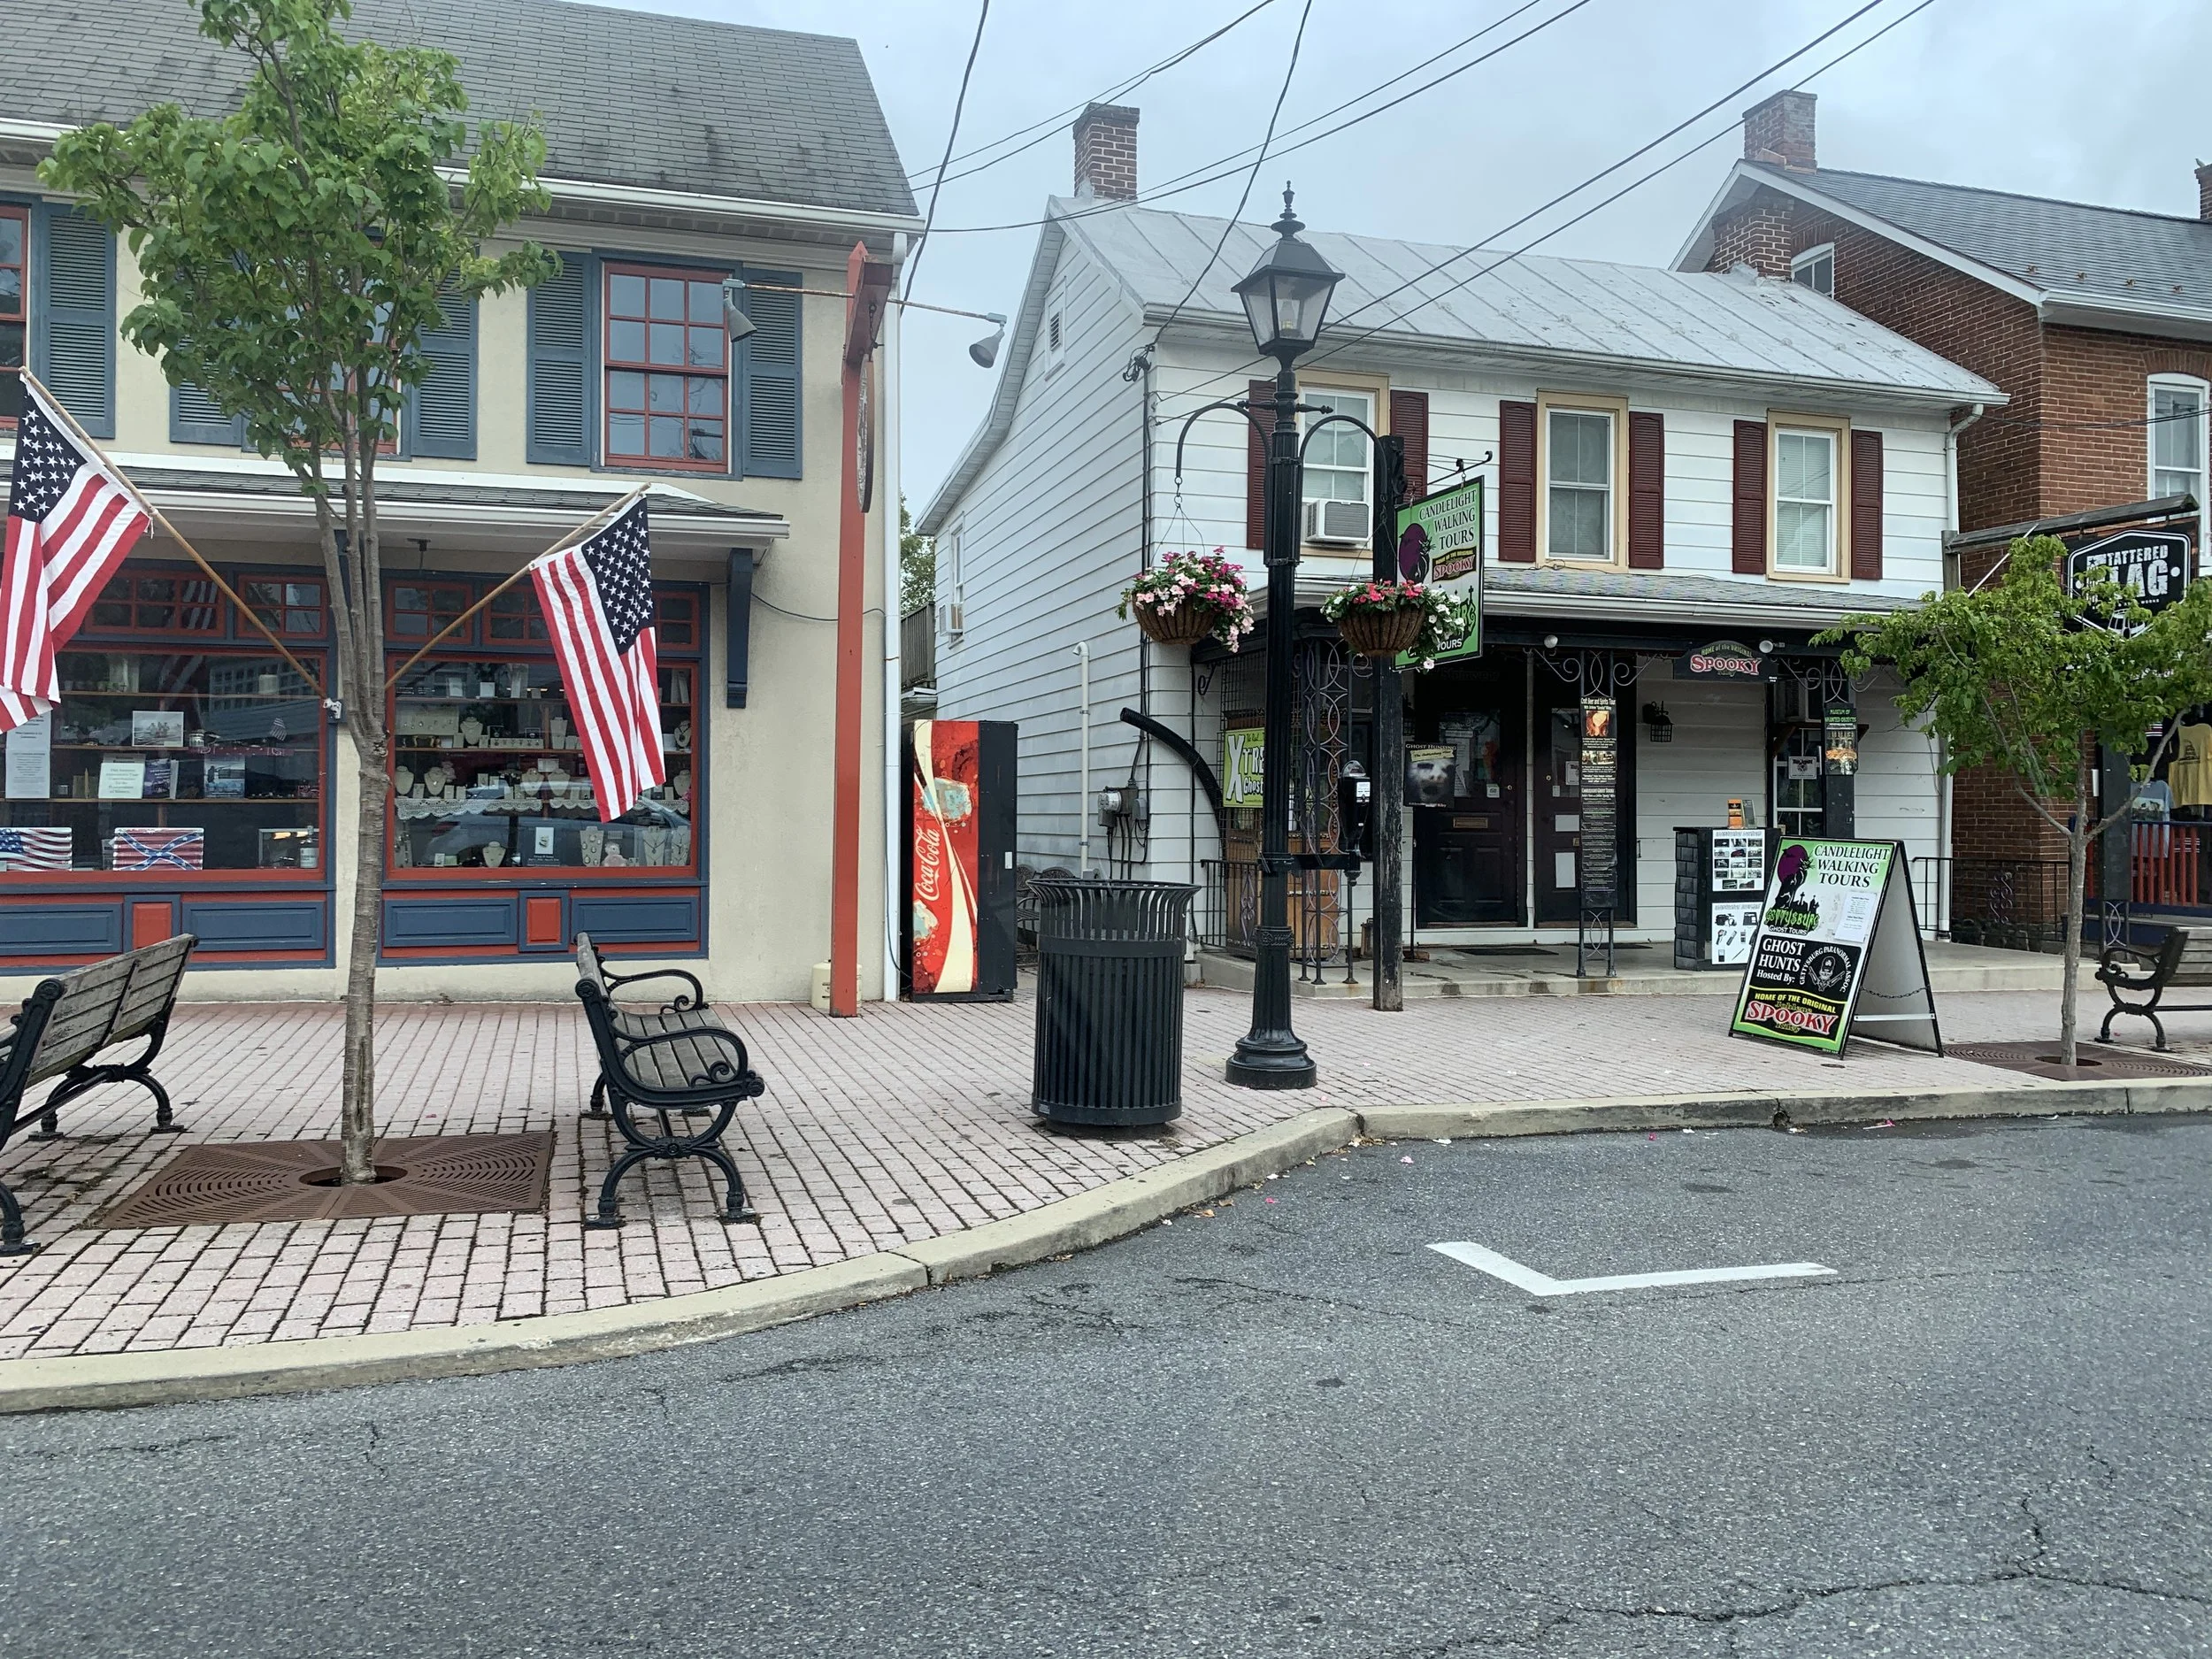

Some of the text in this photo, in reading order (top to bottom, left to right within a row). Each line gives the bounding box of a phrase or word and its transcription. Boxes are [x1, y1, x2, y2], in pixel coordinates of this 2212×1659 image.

[1419, 489, 1478, 521] CANDLELIGHT
[1433, 507, 1476, 534] WALKING
[1439, 526, 1475, 550] TOURS
[2107, 544, 2169, 566] TATTERED
[1433, 554, 1476, 580] SPOOKY
[1701, 645, 1715, 656] HOME
[1690, 655, 1763, 676] SPOOKY
[1243, 777, 1263, 795] Ghost
[1814, 844, 1890, 861] CANDLELIGHT
[1817, 858, 1878, 874] WALKING
[1818, 872, 1871, 887] TOURS
[1788, 926, 1808, 935] TOURS
[1763, 938, 1806, 956] GHOST
[1758, 954, 1801, 972] HUNTS
[1800, 948, 1823, 985] GETTYSBURG
[1823, 946, 1852, 971] PARANORMAL
[1756, 969, 1795, 985] Hosted By:
[1787, 995, 1801, 1003] THE
[1802, 997, 1836, 1014] ORIGINAL
[1744, 1000, 1839, 1035] SPOOKY
